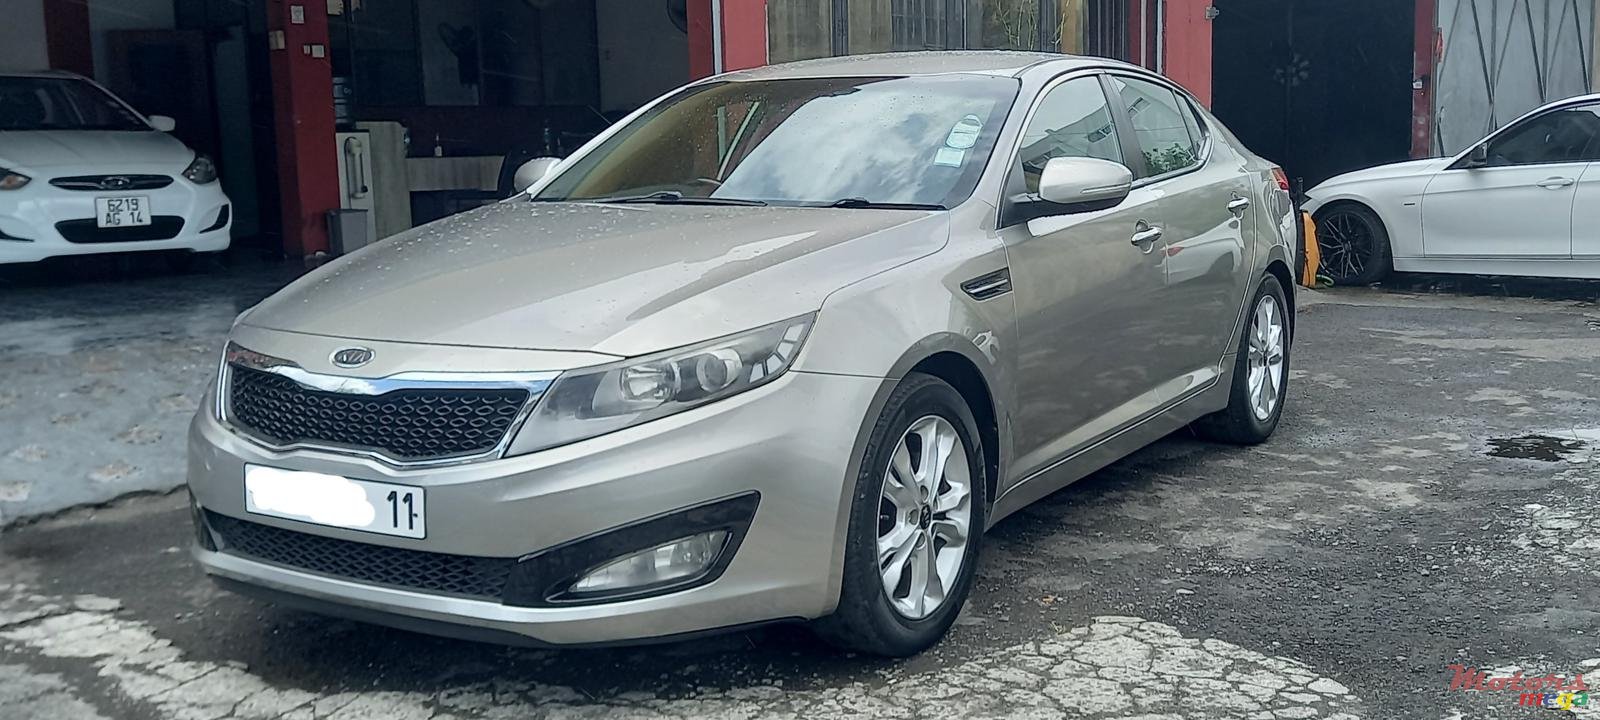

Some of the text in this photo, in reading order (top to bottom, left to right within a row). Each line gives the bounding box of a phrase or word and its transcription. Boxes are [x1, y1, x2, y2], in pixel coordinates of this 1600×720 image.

[107, 199, 139, 212] 6219
[105, 211, 143, 225] AG 14
